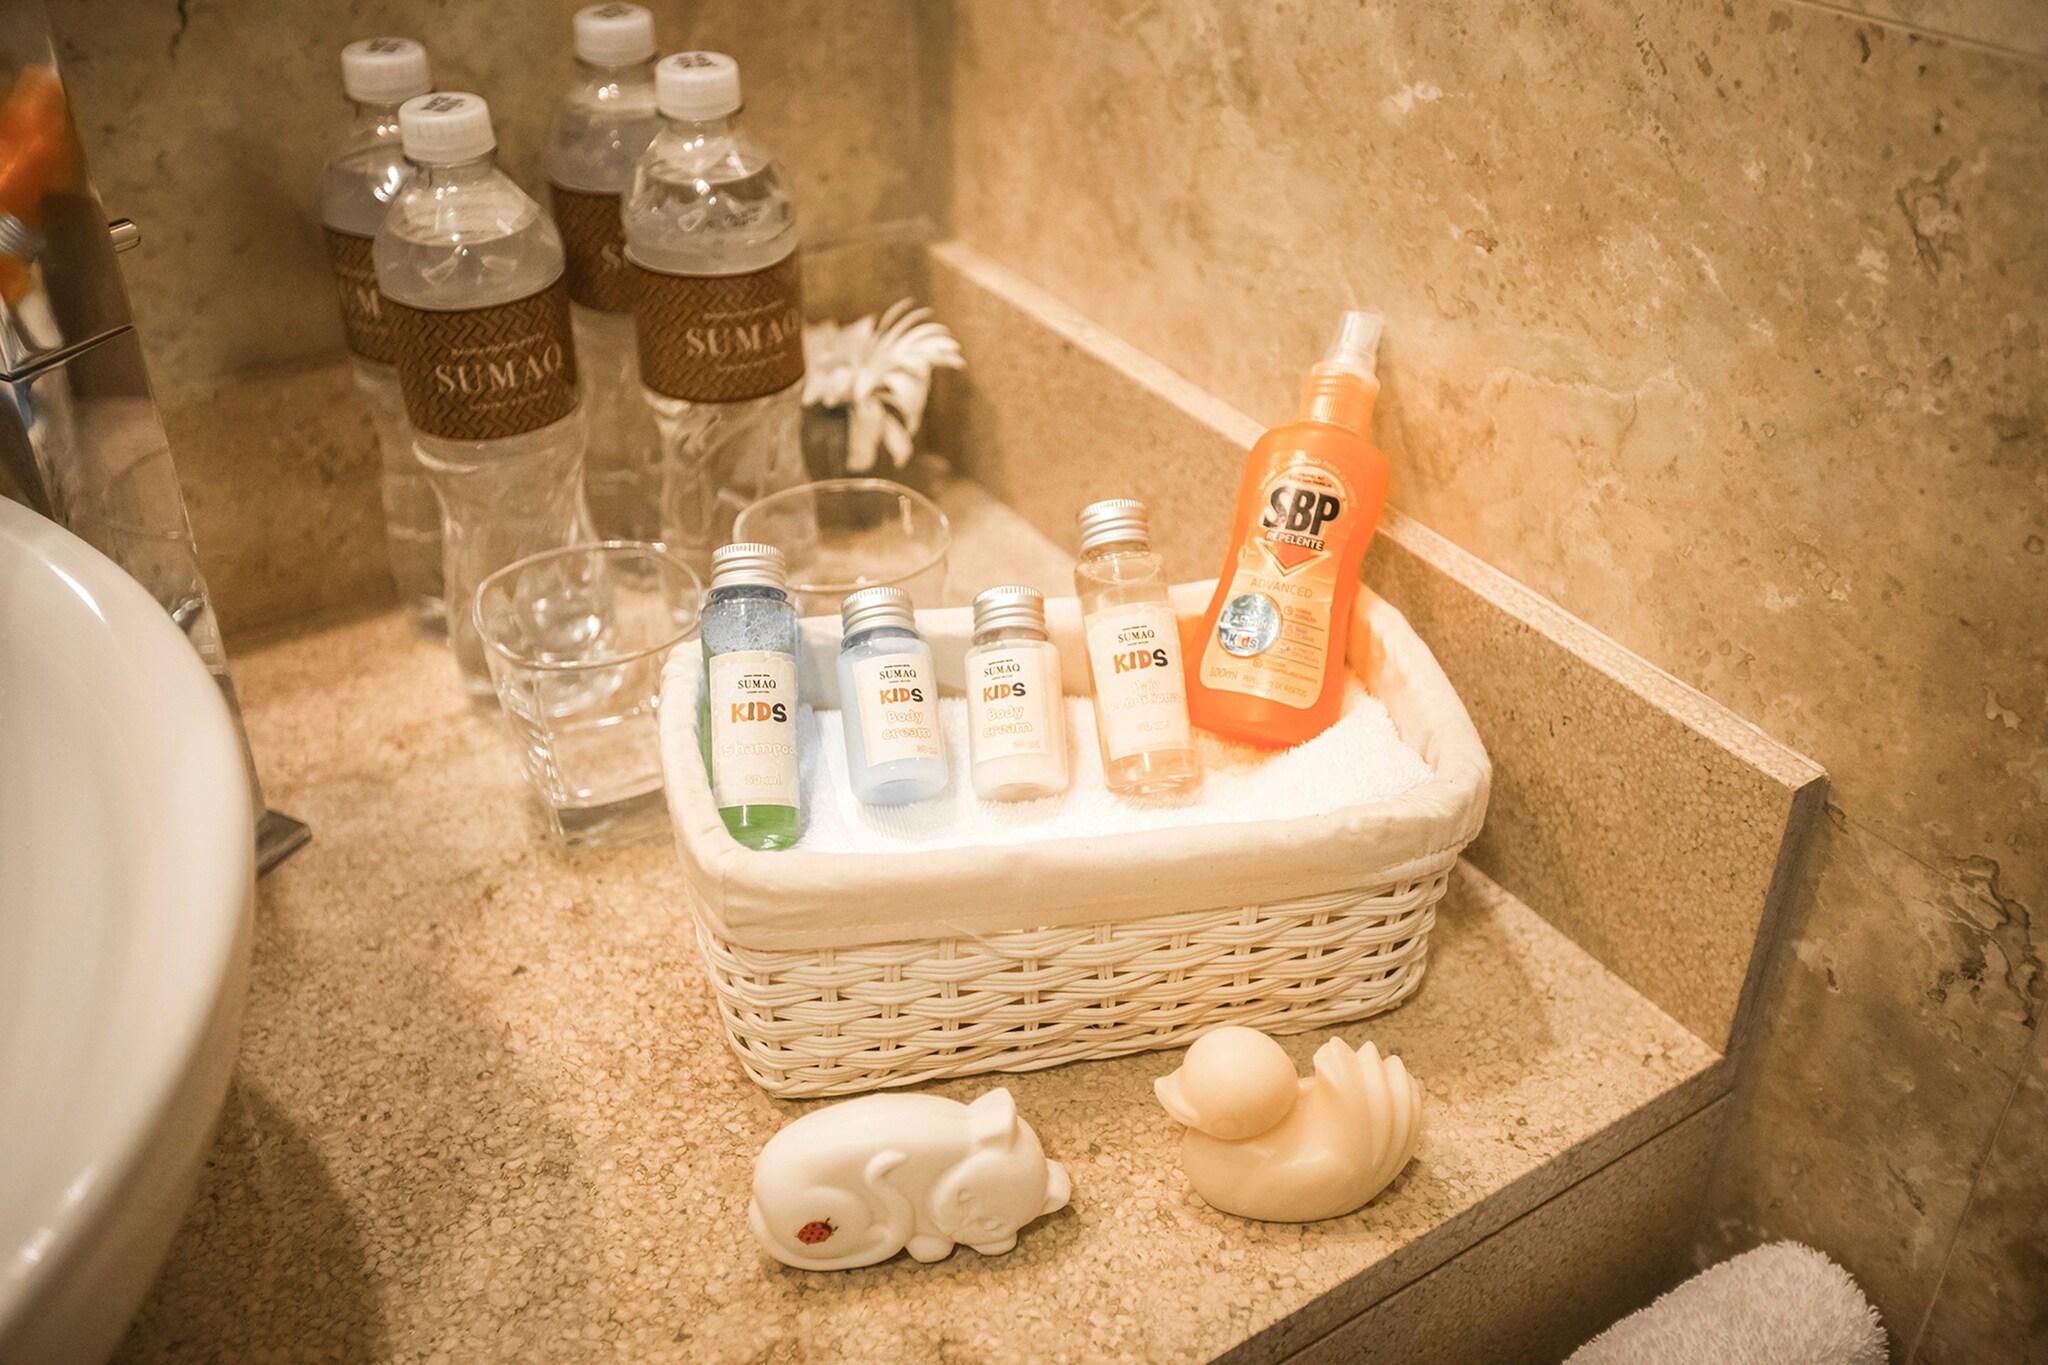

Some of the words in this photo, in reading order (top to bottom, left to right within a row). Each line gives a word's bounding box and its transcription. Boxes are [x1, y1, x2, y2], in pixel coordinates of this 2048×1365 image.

[684, 310, 800, 358] SUMAQ
[434, 343, 563, 396] SUMAQ
[1262, 485, 1341, 537] SBP
[1265, 531, 1325, 551] REPELENTE
[1250, 577, 1313, 599] ADVANCED
[1117, 630, 1155, 643] SUMAQ
[983, 663, 1021, 677] SUMAQ
[1113, 648, 1169, 674] KIDS
[879, 668, 917, 680] SUMAQ
[737, 679, 777, 689] SUMAQ
[982, 682, 1027, 703] KIDS
[879, 687, 924, 705] KIDS
[731, 702, 788, 723] KIDS
[886, 709, 924, 724] Body
[987, 704, 1024, 721] Body
[881, 727, 932, 741] cream
[983, 721, 1033, 738] cream
